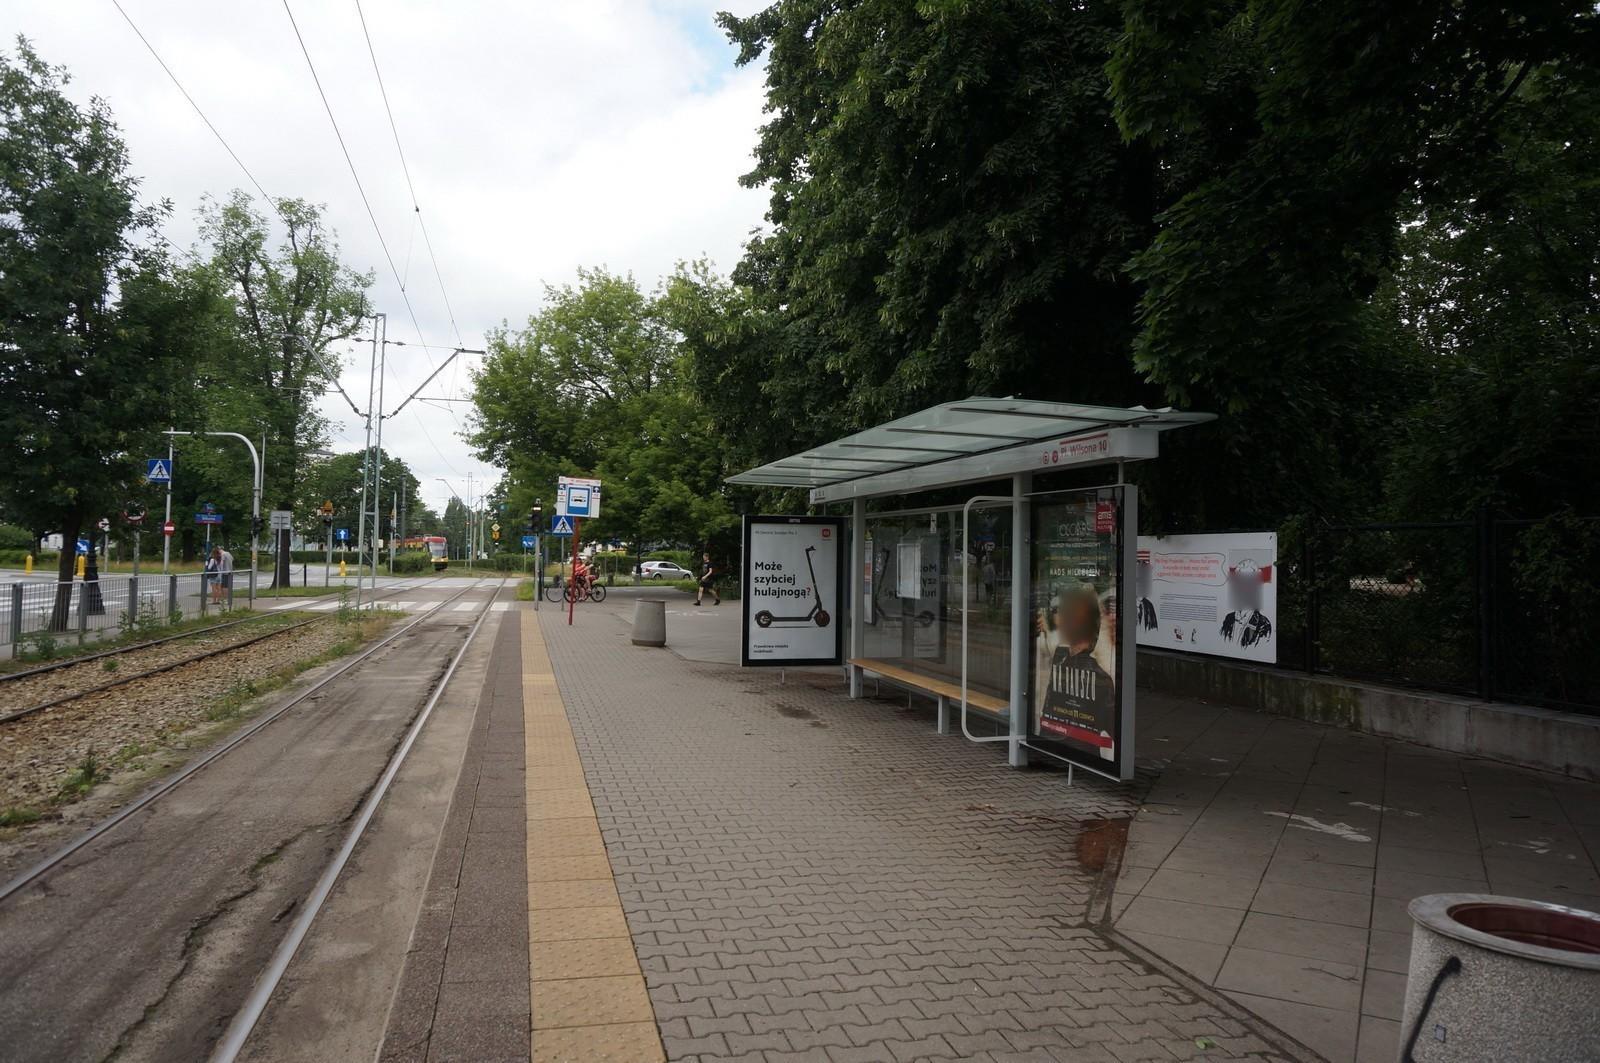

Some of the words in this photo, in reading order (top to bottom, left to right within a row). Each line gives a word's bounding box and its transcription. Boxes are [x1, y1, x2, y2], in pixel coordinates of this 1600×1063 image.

[1070, 443, 1096, 456] Wilsona
[1099, 439, 1107, 452] 10
[755, 561, 782, 571] Może
[754, 574, 796, 585] szybciej
[754, 587, 811, 599] hulajnogą?
